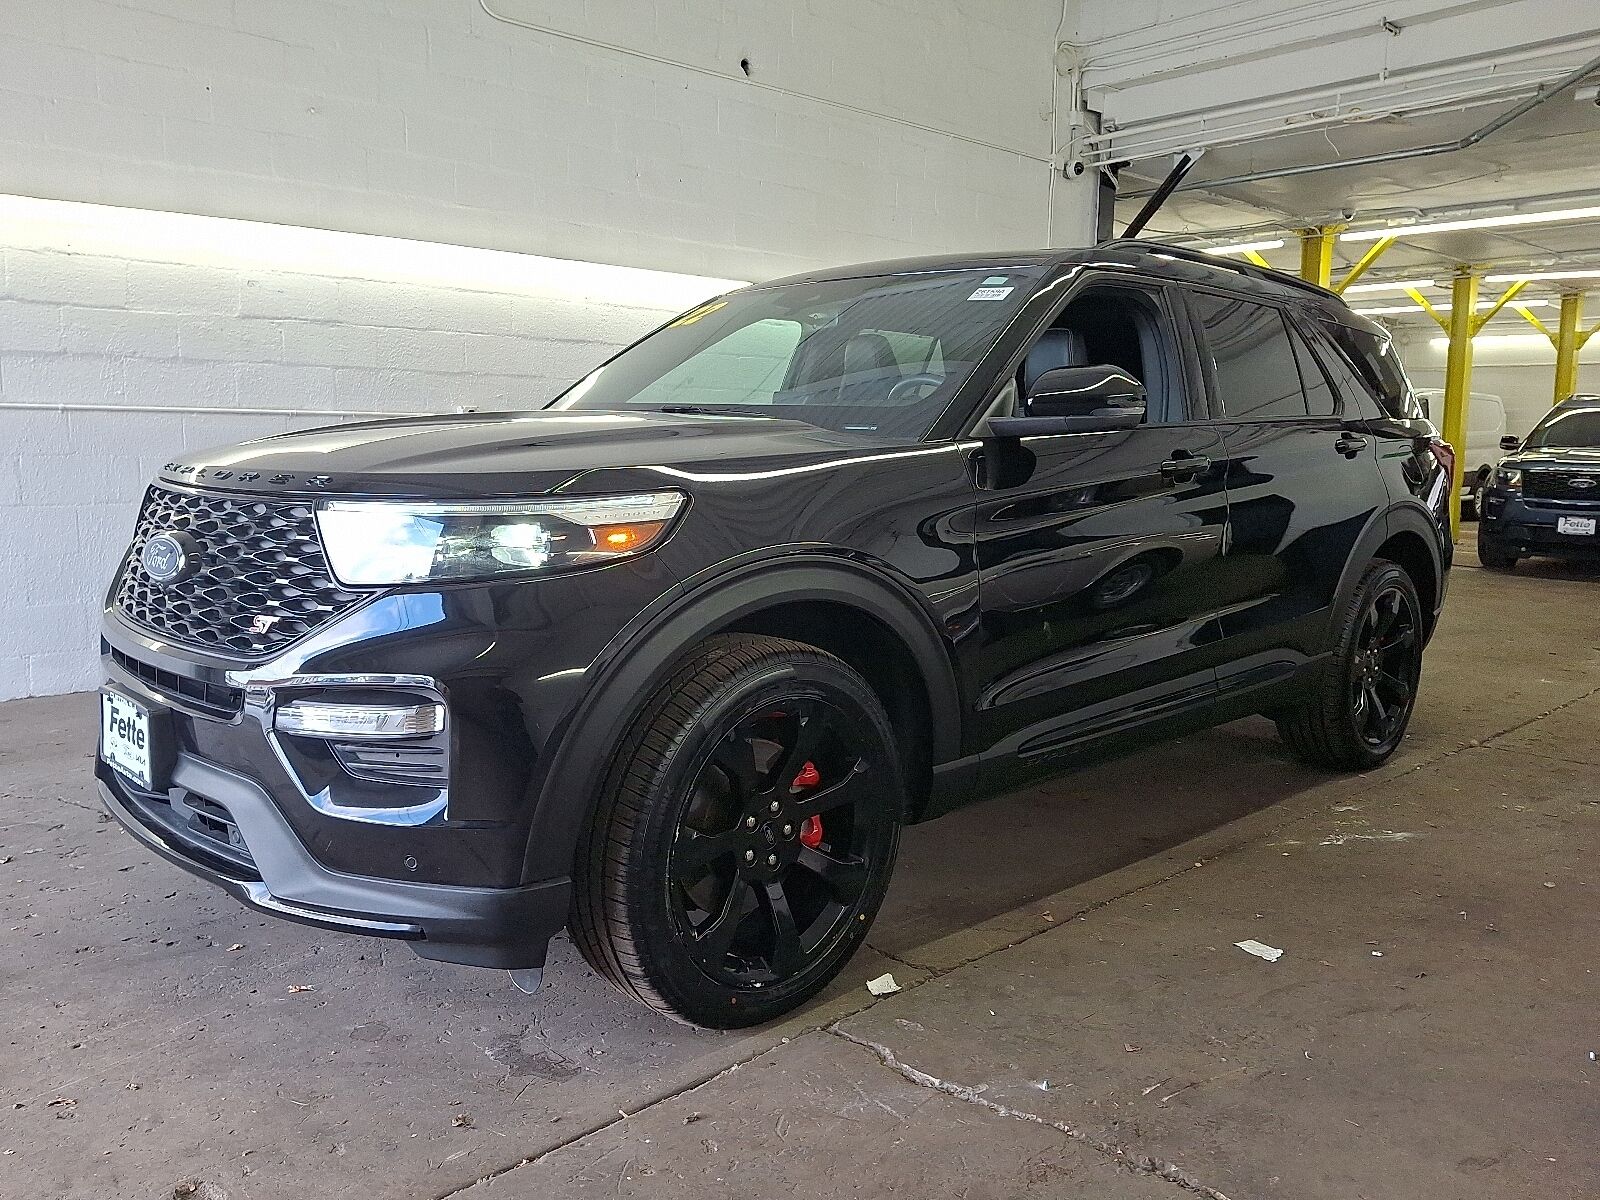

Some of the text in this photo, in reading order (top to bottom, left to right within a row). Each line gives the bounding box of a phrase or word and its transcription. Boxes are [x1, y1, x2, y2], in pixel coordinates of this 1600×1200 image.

[146, 543, 171, 570] Ford
[250, 615, 280, 635] ST
[109, 705, 145, 750] Fette
